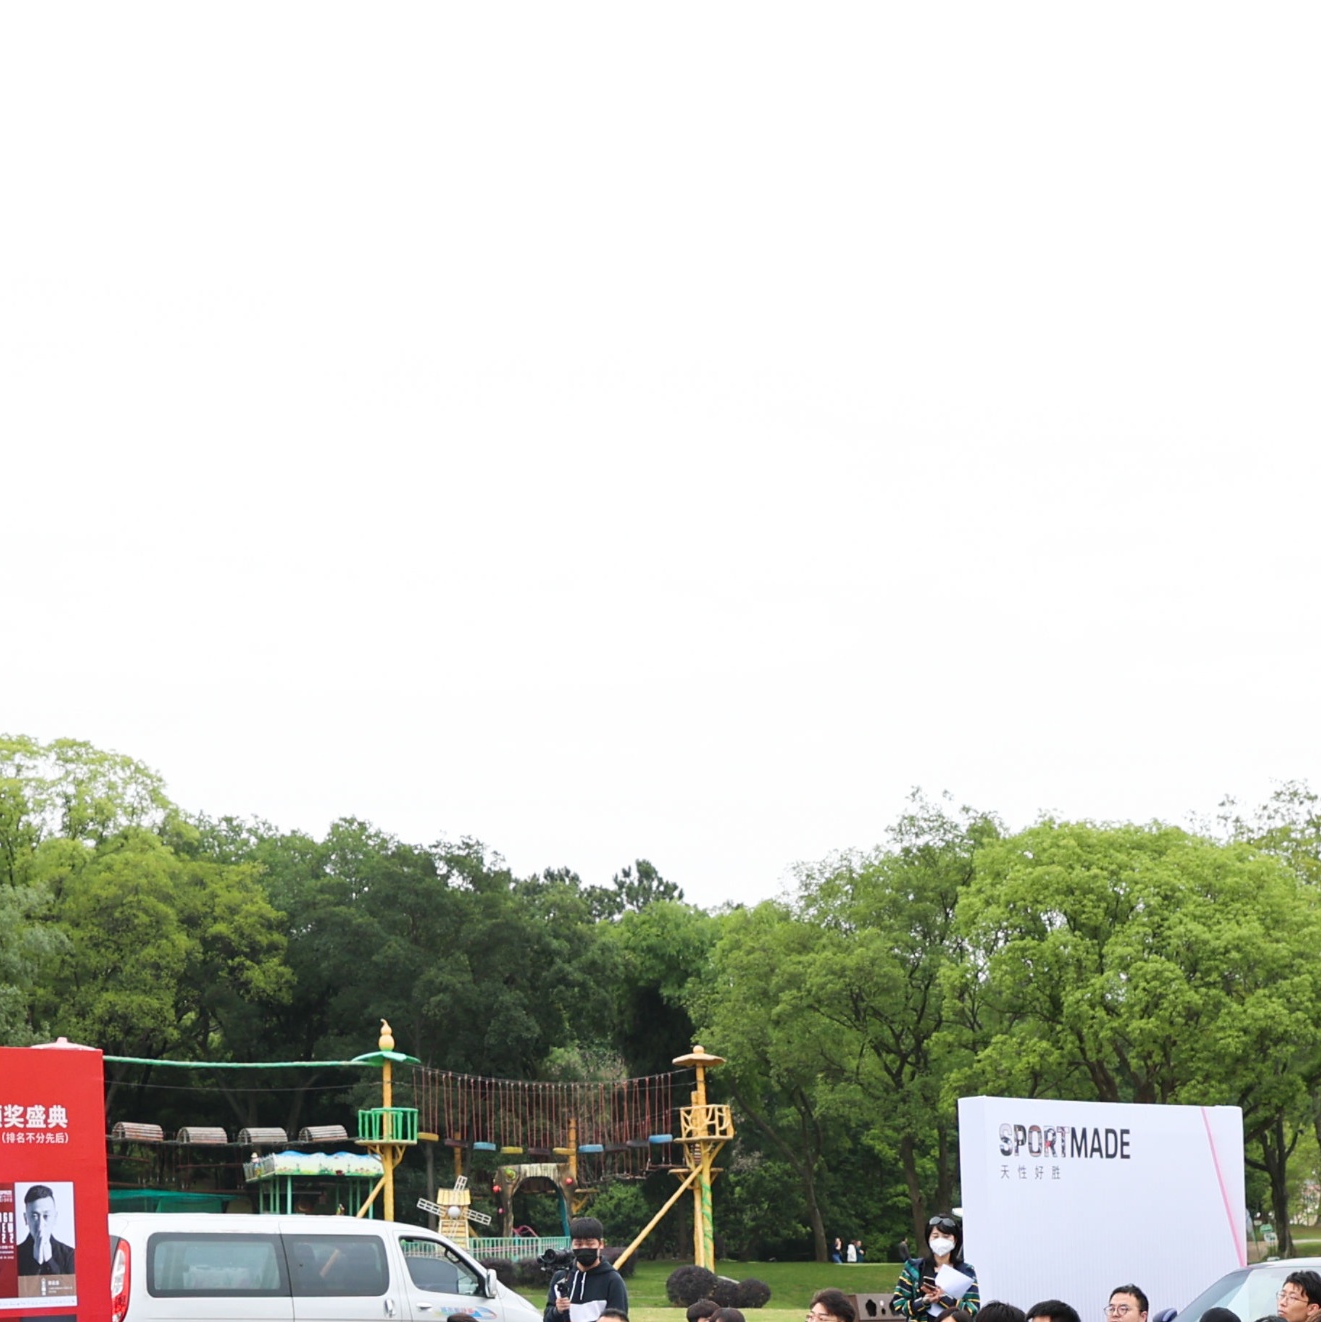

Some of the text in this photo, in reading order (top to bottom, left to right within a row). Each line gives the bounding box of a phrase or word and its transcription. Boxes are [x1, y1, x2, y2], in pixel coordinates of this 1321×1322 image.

[1, 1132, 69, 1144] (排名不分先后)
[999, 1123, 1131, 1159] SPORTMADE
[1000, 1164, 1061, 1180] 天性好胜
